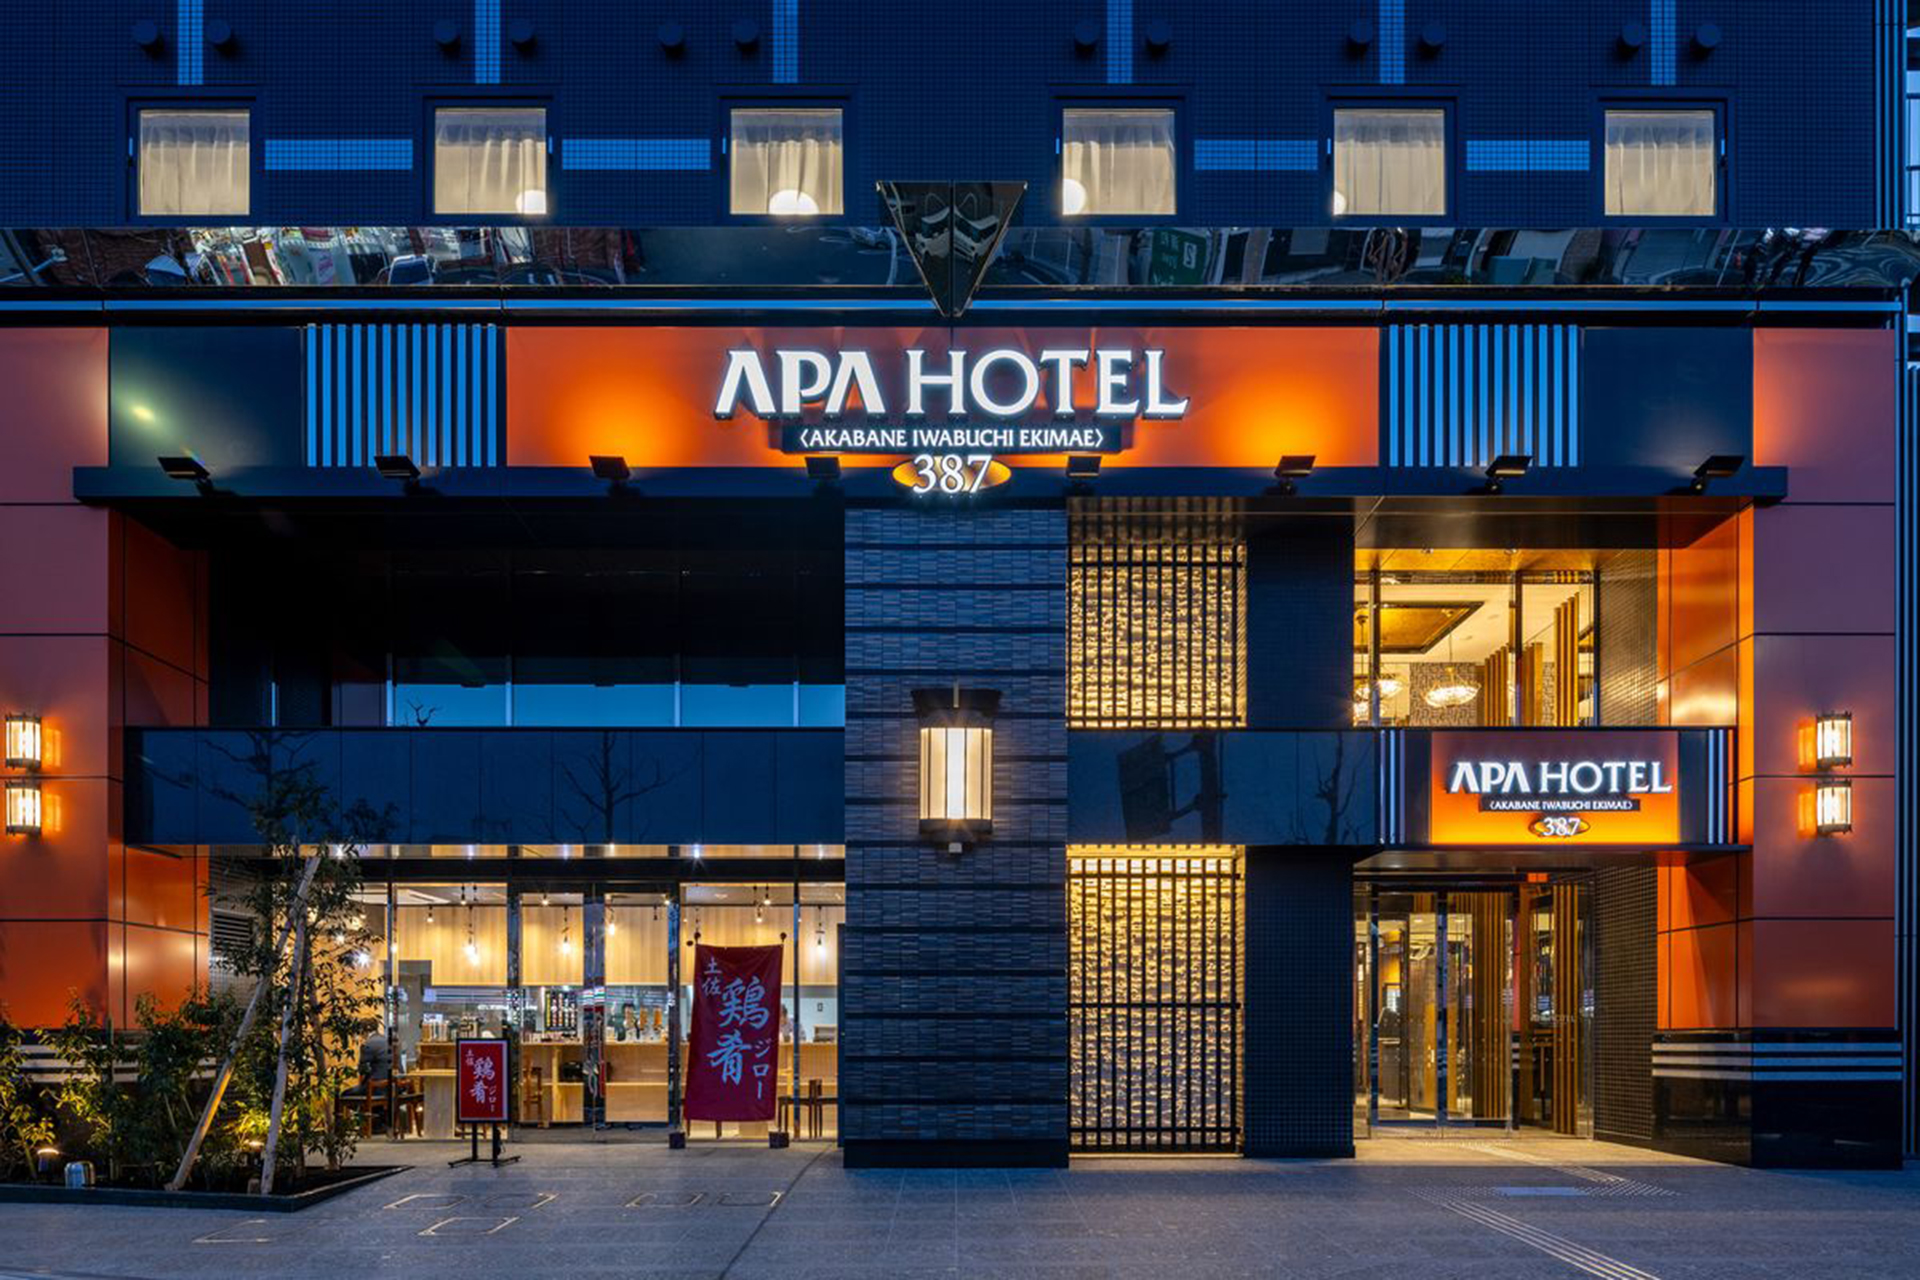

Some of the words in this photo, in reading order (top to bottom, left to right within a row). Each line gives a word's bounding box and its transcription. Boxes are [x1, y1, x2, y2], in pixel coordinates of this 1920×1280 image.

[714, 349, 887, 416] APA
[906, 349, 1189, 417] HOTEL
[912, 428, 1017, 448] IWABUCHI
[912, 453, 993, 494] 387
[1450, 761, 1532, 793] APA
[1538, 761, 1673, 793] HOTEL
[1542, 800, 1592, 811] IWABUCHI
[1542, 817, 1581, 836] 387
[752, 1037, 772, 1100] ジロー
